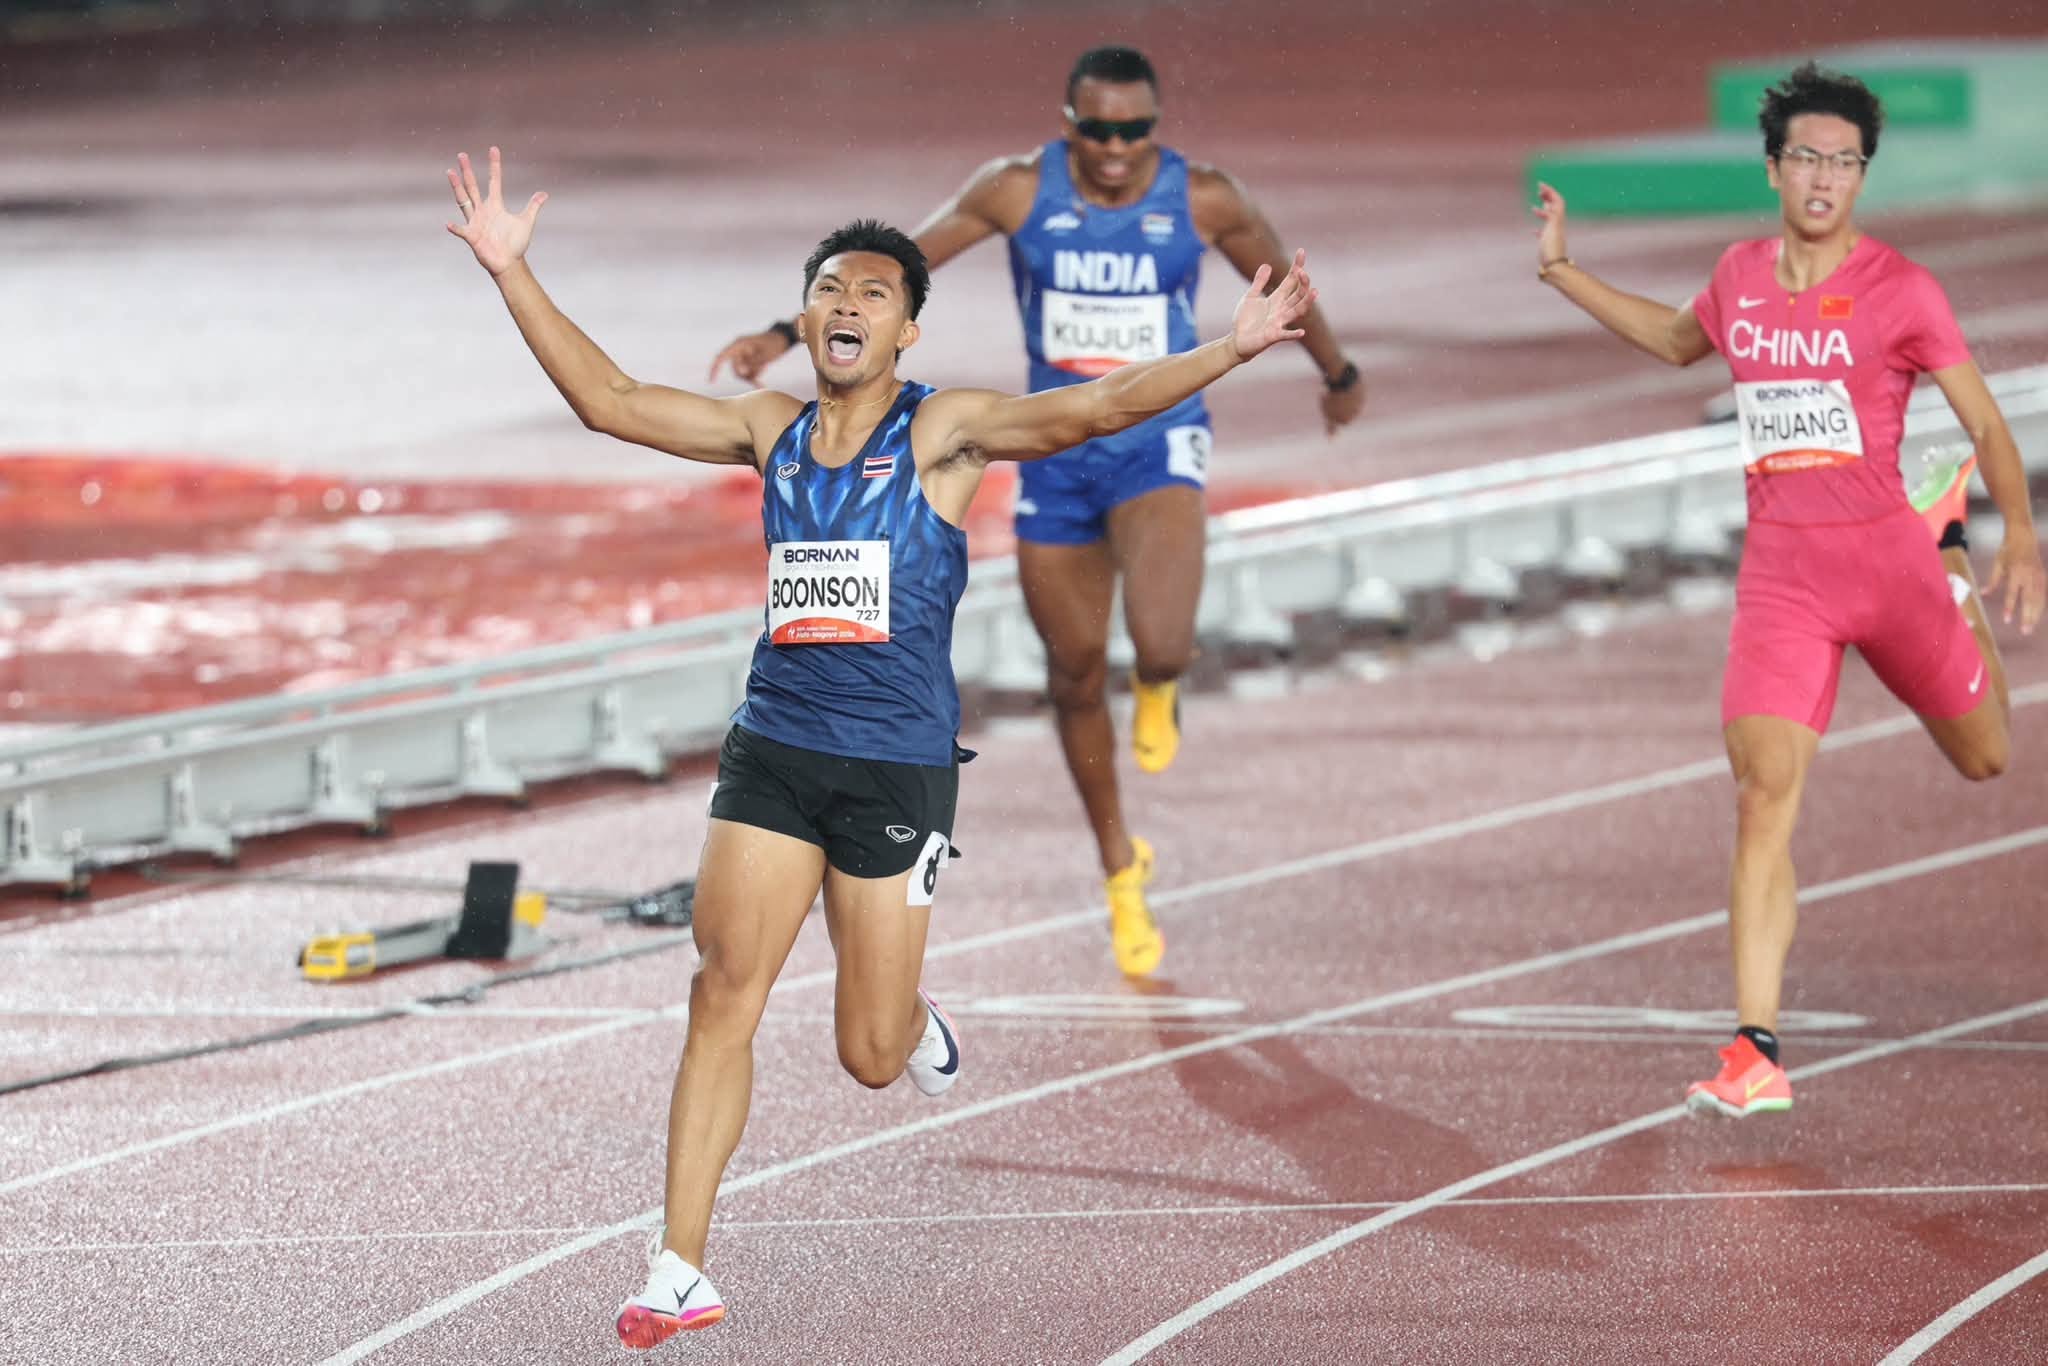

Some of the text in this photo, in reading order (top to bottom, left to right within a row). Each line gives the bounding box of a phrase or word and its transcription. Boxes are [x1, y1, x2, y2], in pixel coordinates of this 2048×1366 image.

[1054, 250, 1158, 293] INDIA
[1054, 322, 1155, 350] KUJUR
[1729, 320, 1853, 367] CHINA
[1756, 385, 1824, 401] BORNAN
[784, 548, 859, 563] BORNAN
[772, 576, 879, 609] BOONSON
[856, 609, 880, 621] 727
